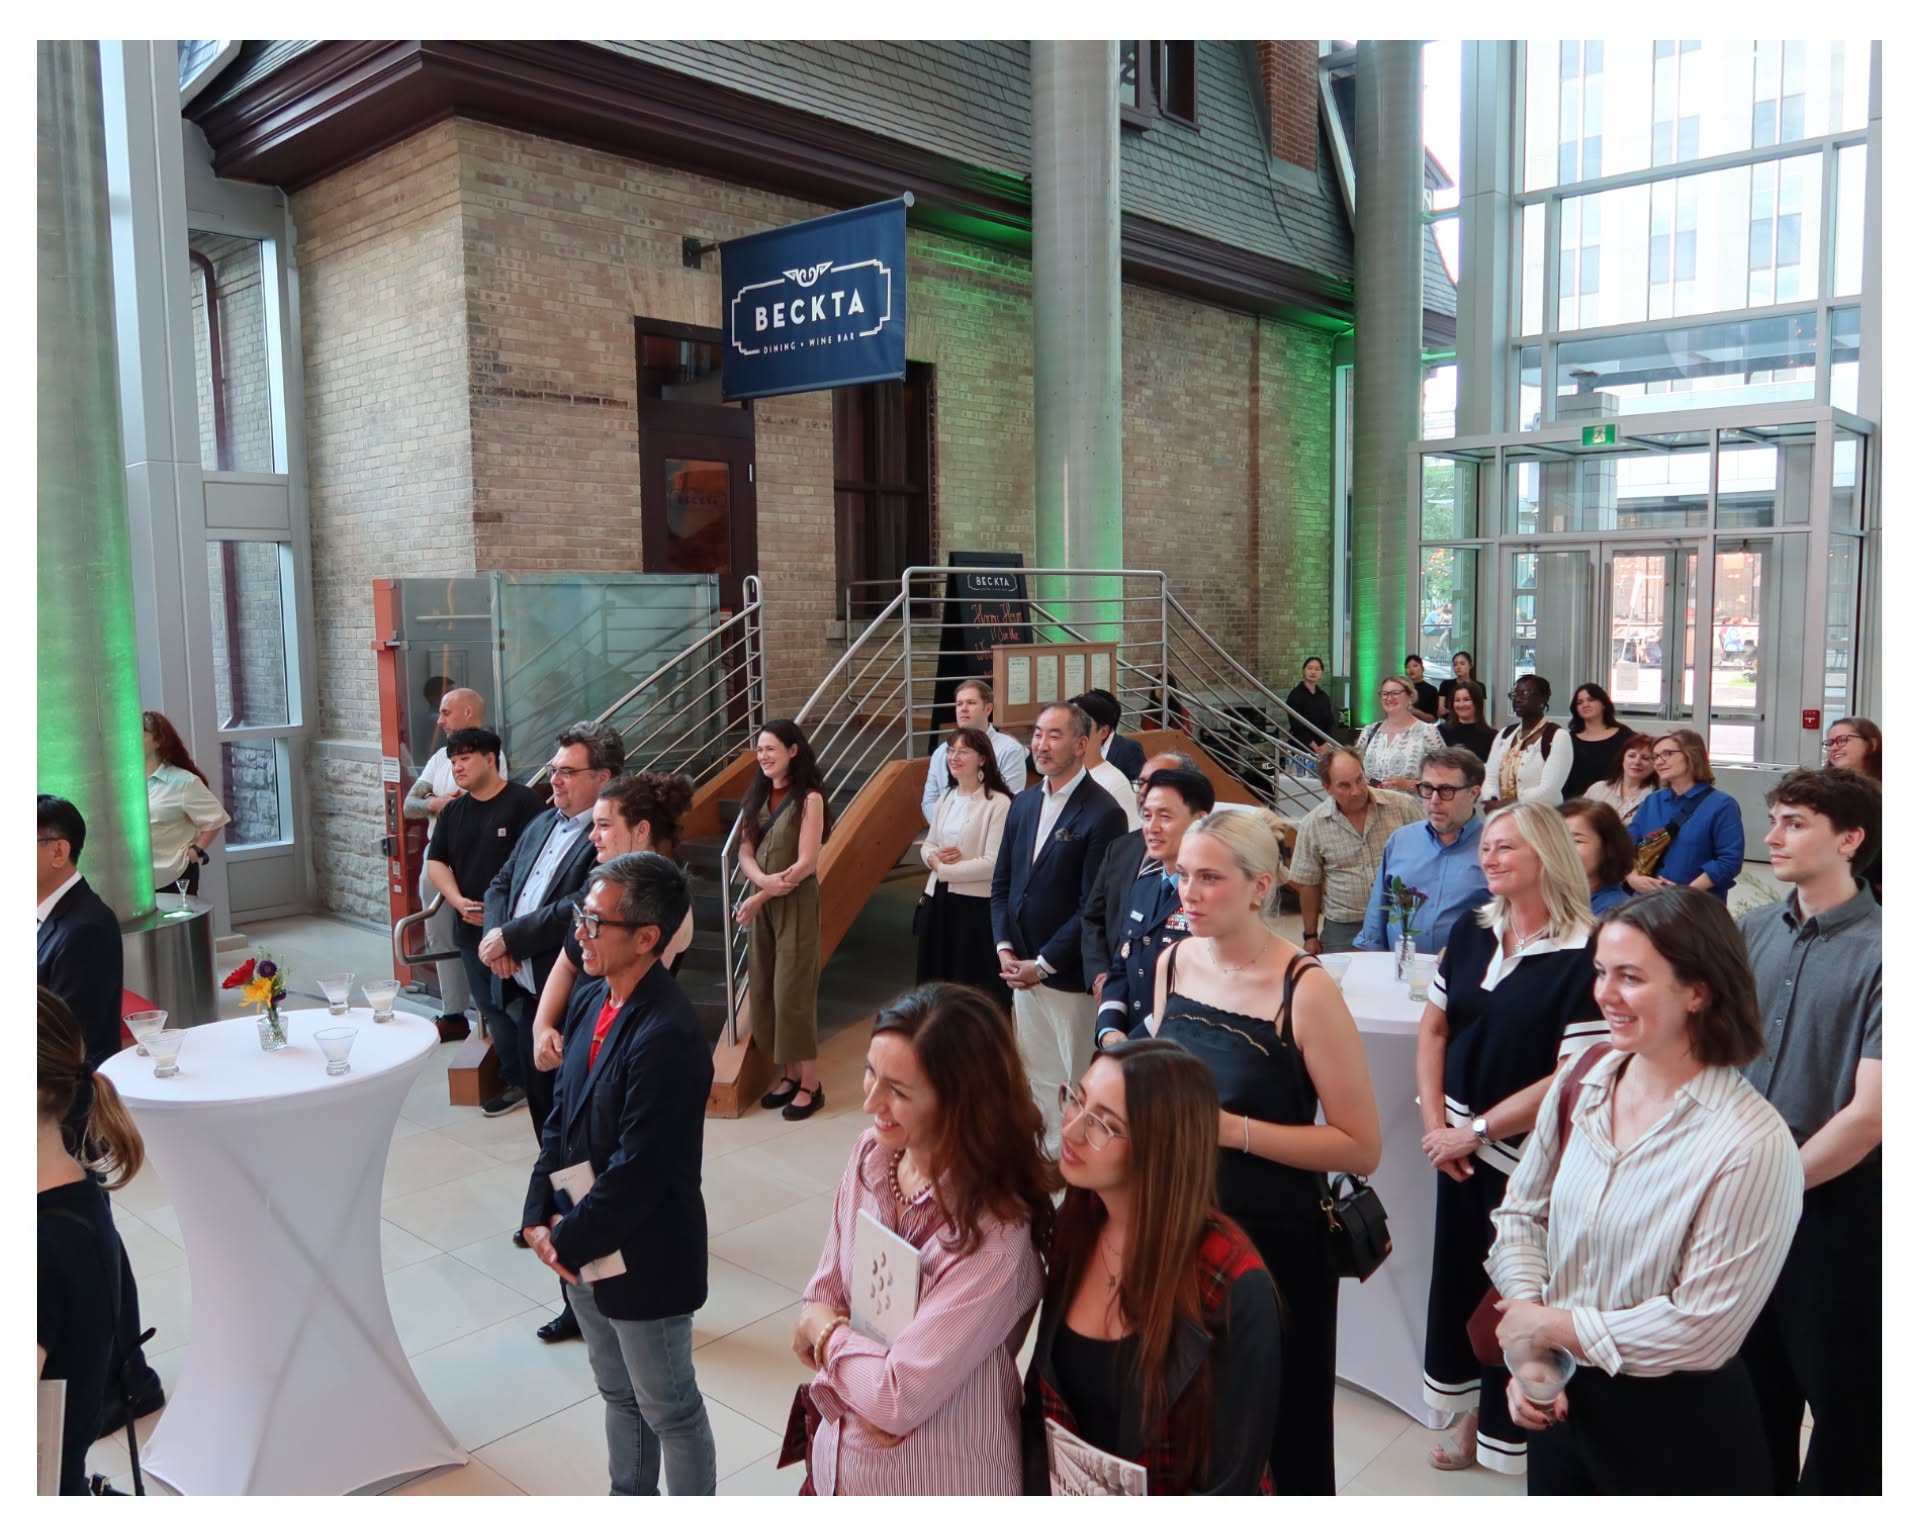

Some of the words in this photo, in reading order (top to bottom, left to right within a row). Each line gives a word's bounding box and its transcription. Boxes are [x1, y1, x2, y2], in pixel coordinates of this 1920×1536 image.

[755, 287, 865, 332] BECKTA
[763, 342, 796, 354] DINING
[809, 336, 832, 347] WINE
[837, 332, 854, 343] BAR
[976, 576, 1010, 586] BECKTA
